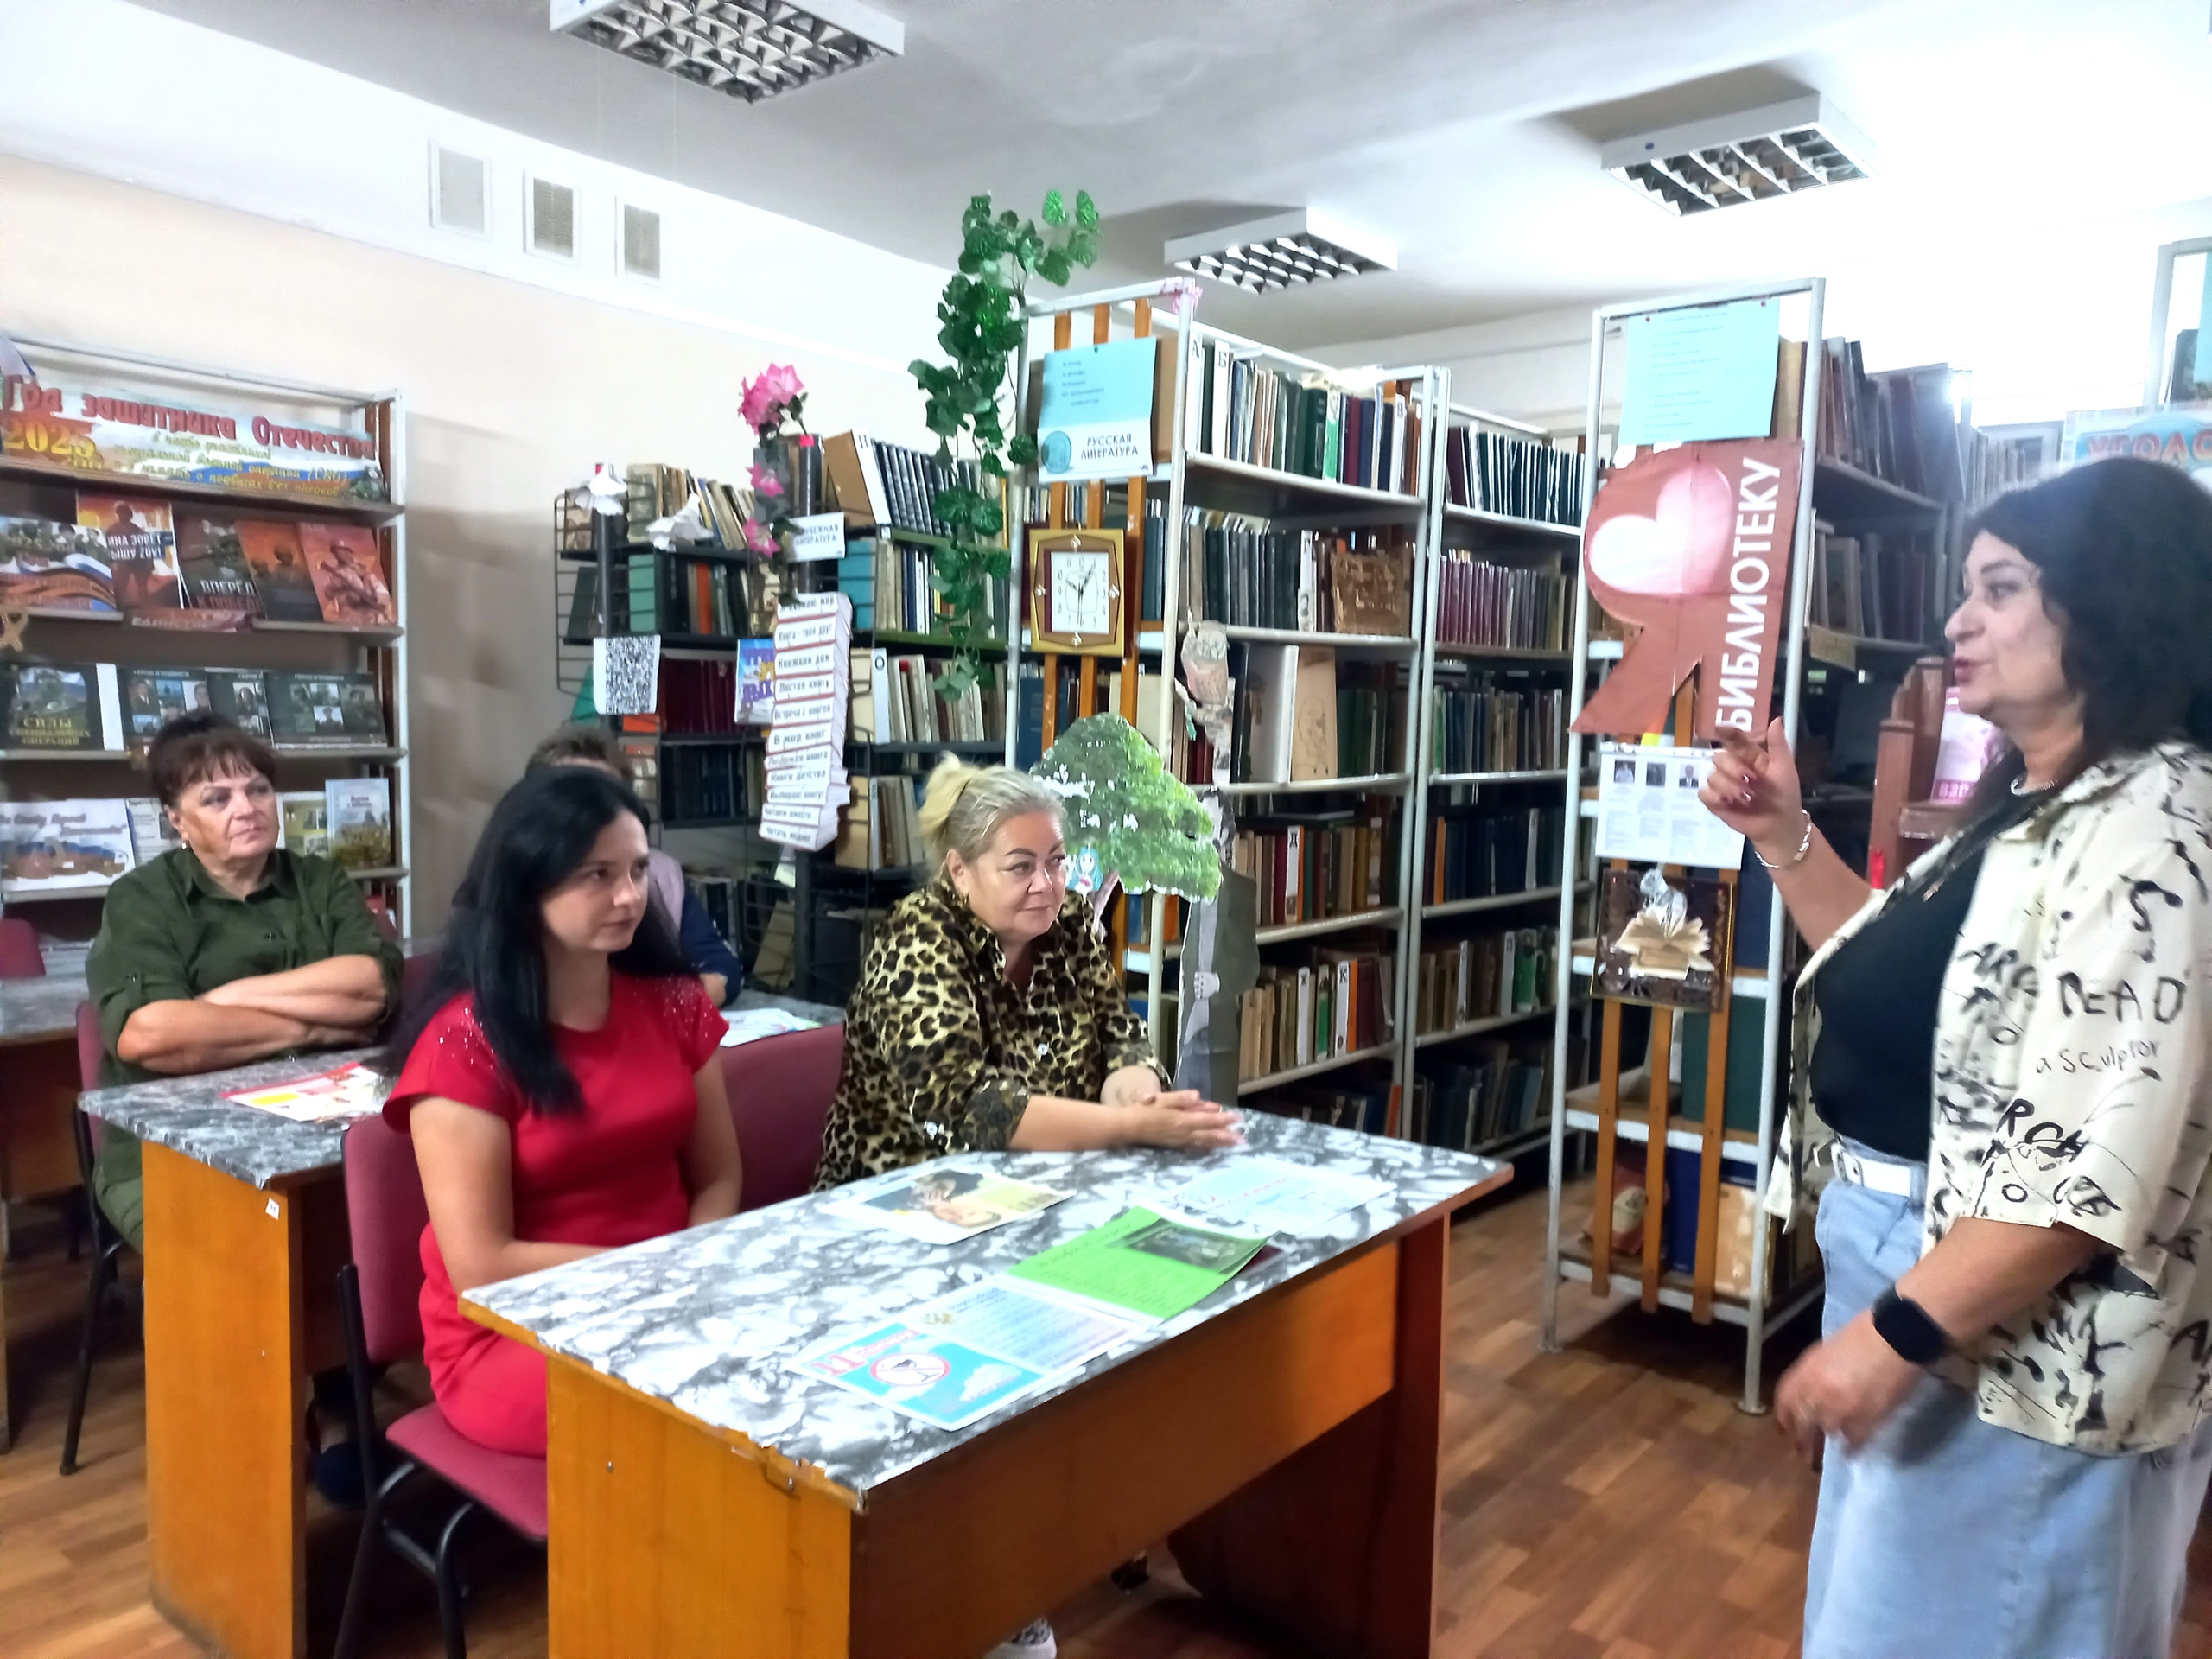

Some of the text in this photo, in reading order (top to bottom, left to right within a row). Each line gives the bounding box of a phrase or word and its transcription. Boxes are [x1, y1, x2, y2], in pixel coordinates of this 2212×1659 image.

[3, 374, 63, 413] Год
[251, 416, 376, 461] Отечества
[1087, 433, 1132, 447] РУССКАЯ
[1080, 445, 1139, 460] ЛИТЕРАТУРА
[1715, 456, 1781, 732] БИБЛИОТЕКУ
[816, 654, 830, 665] дом
[774, 734, 780, 745] В
